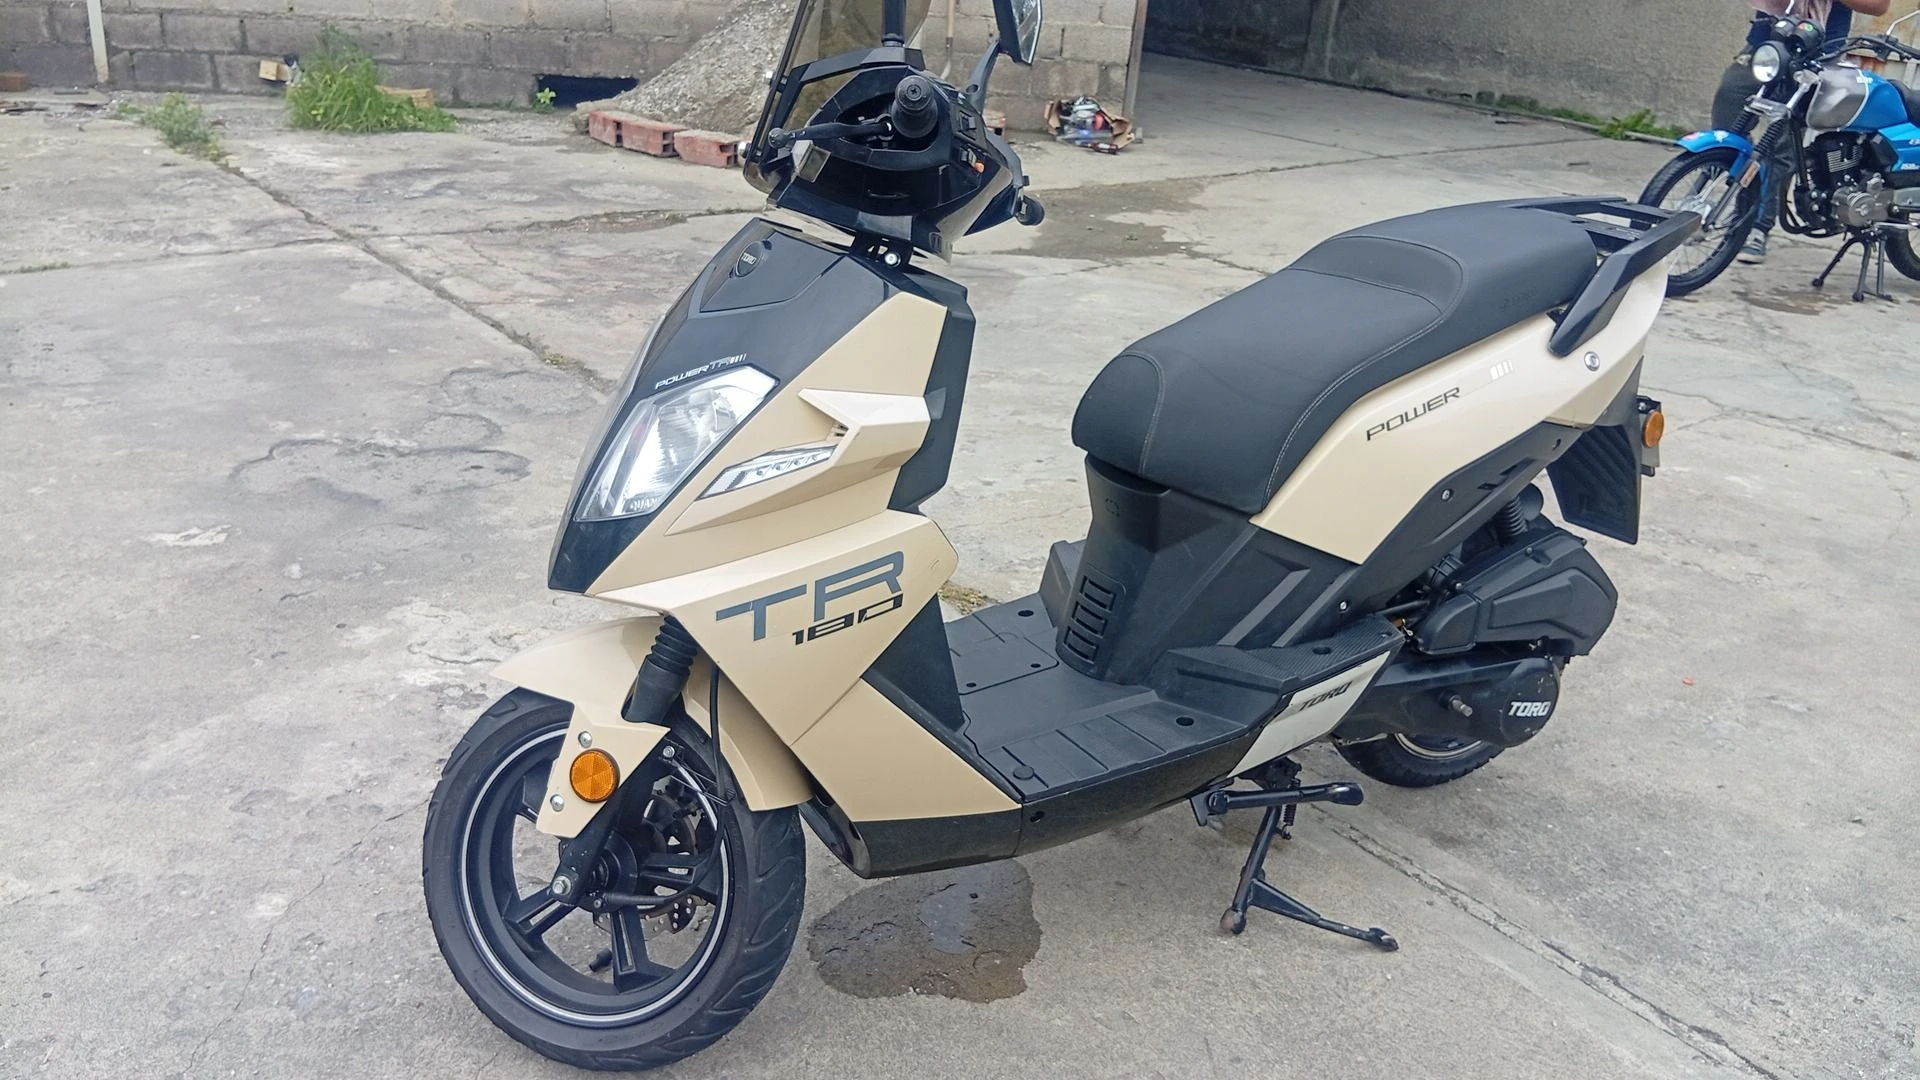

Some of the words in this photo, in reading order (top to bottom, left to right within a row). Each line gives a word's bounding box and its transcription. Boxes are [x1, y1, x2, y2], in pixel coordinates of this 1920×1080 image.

[741, 252, 757, 265] TORO
[1366, 387, 1460, 441] POWER
[716, 551, 904, 641] TR
[792, 593, 904, 645] 180
[1299, 681, 1353, 712] TORO
[1508, 701, 1551, 717] TORO
